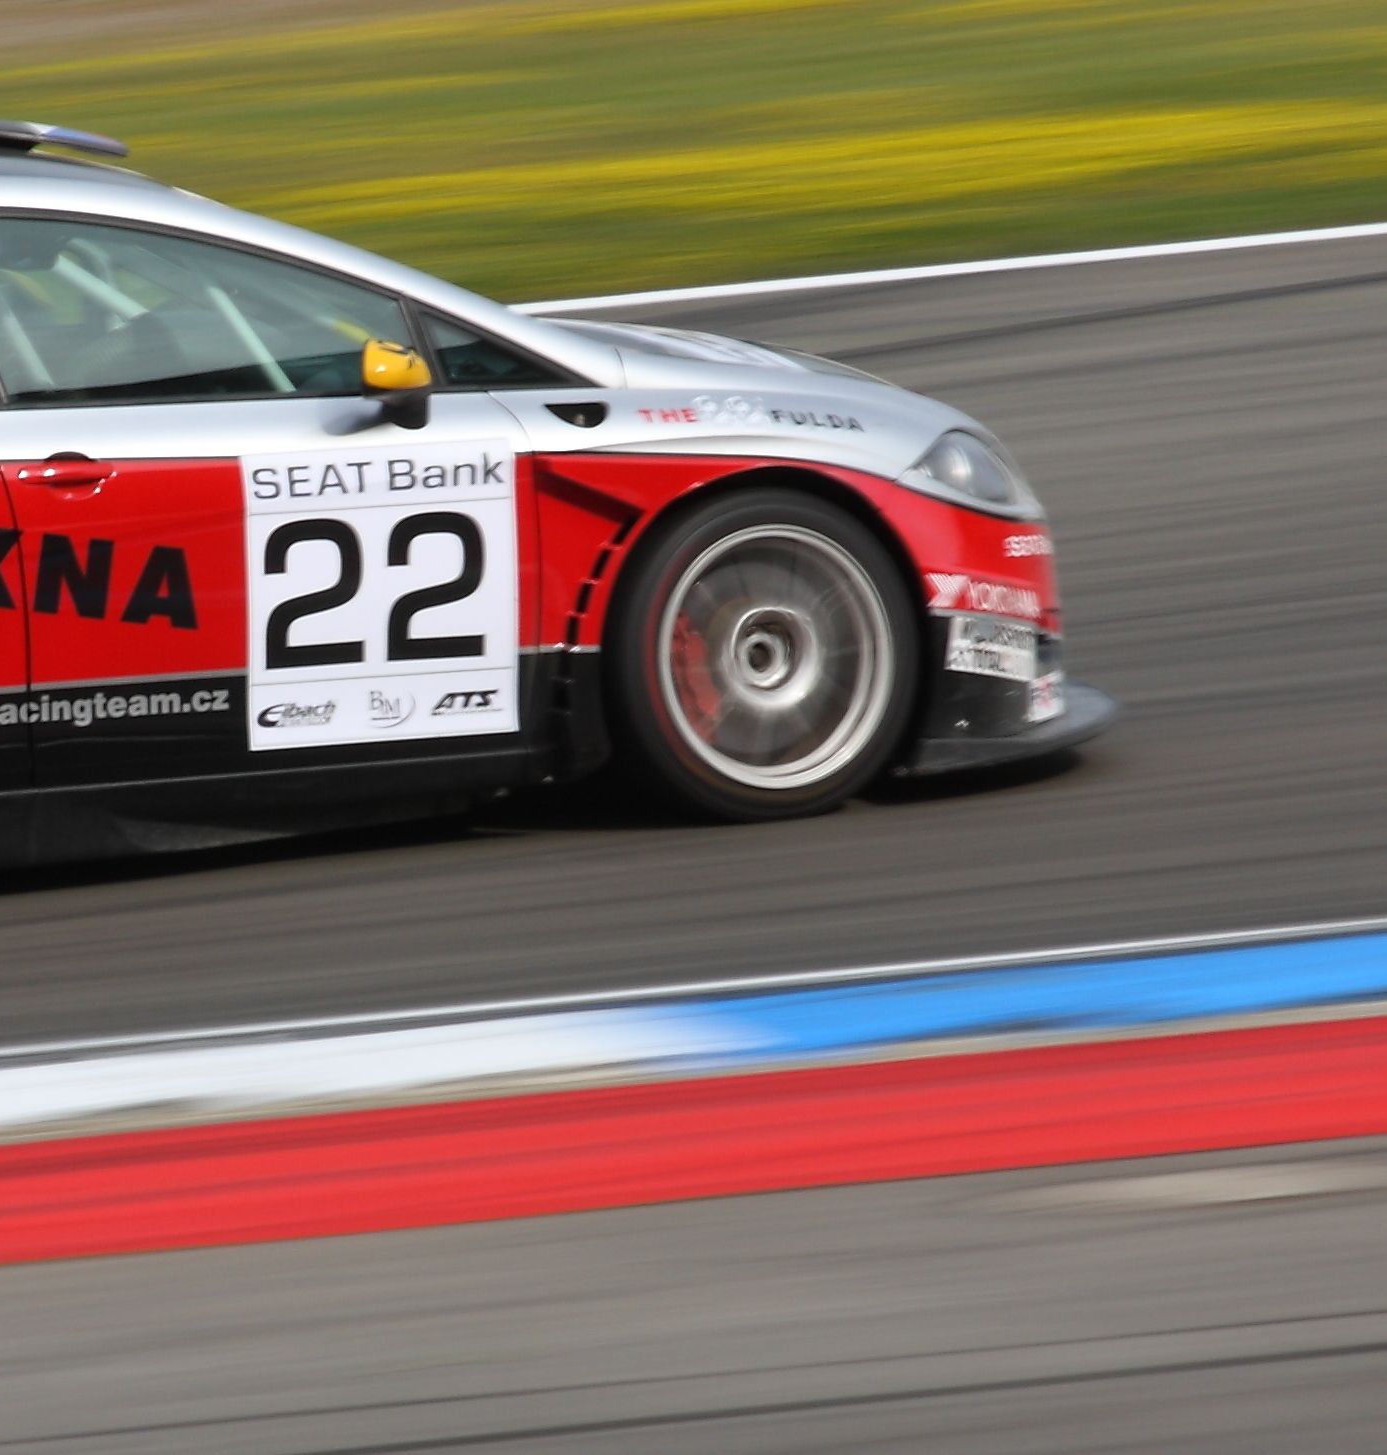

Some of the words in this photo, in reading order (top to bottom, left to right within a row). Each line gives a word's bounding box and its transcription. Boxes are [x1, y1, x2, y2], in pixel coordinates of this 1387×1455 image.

[637, 408, 699, 424] THE
[769, 409, 865, 433] FULDA
[252, 462, 373, 499] SEAT
[387, 453, 505, 491] Bank
[264, 511, 486, 670] 22
[432, 689, 498, 710] ATS
